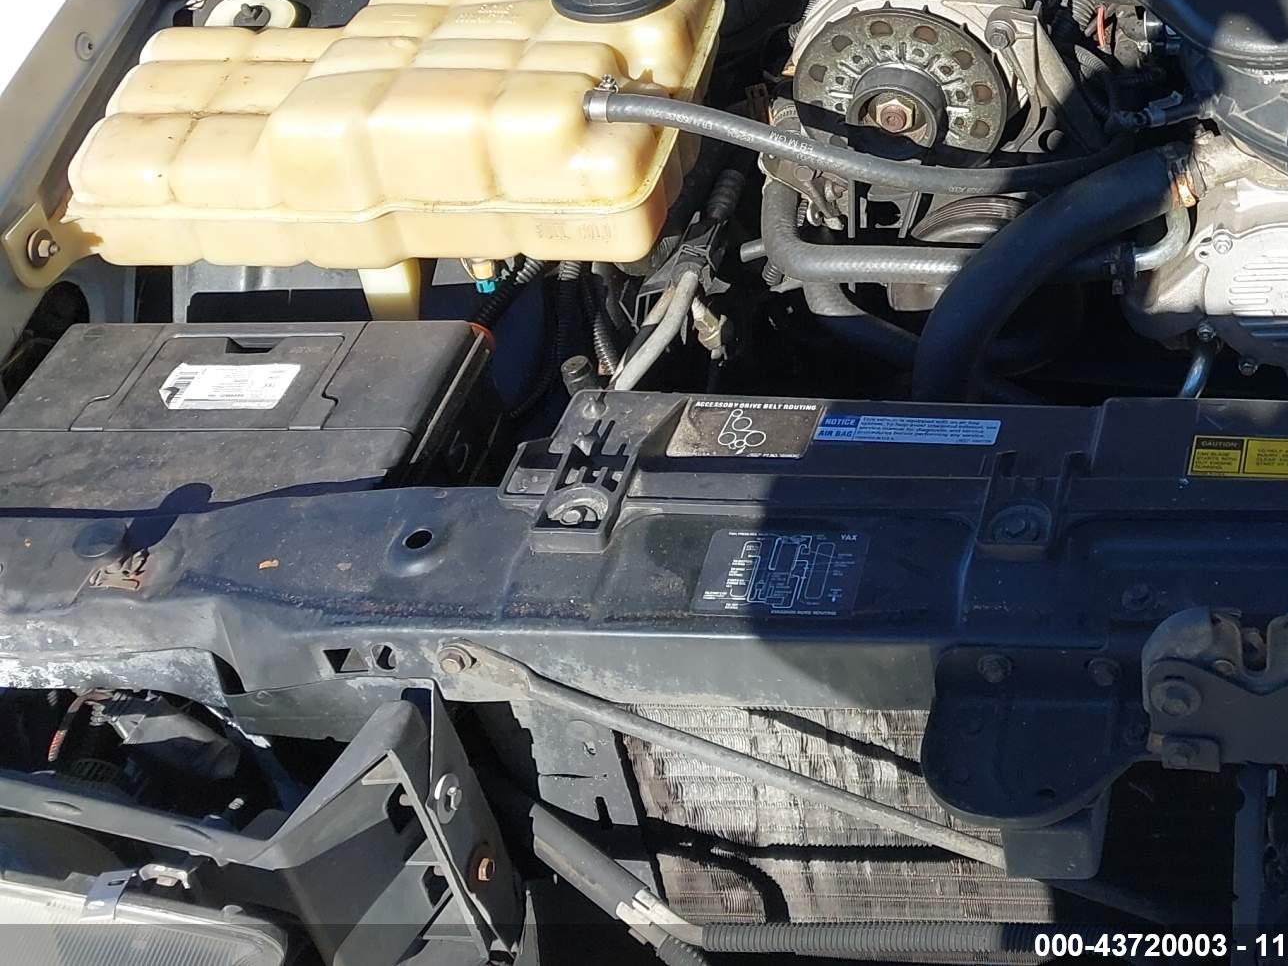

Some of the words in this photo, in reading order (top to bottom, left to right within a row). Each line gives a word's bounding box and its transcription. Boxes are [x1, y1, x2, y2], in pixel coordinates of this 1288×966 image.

[695, 401, 739, 409] ACCESSORY
[824, 418, 856, 426] NOTICE
[1201, 440, 1241, 448] CAUTION
[840, 533, 858, 541] YAX
